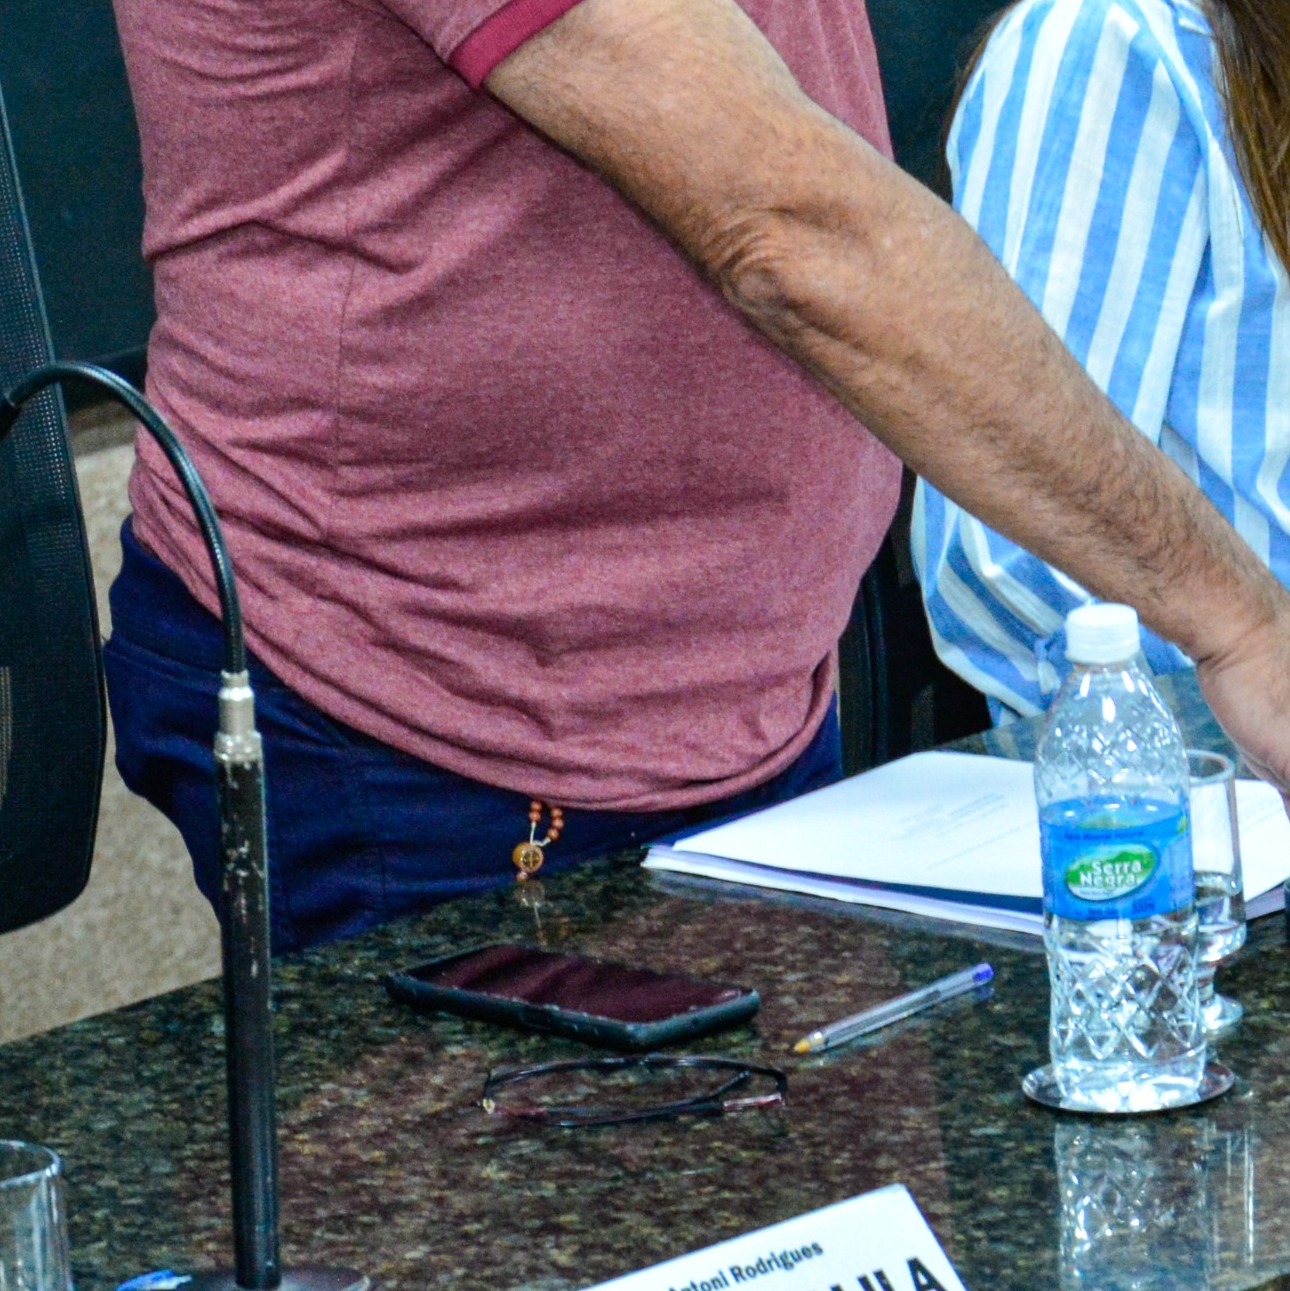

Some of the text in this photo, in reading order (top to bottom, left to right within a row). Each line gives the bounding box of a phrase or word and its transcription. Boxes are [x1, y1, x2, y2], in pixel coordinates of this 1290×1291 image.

[1091, 859, 1143, 875] Serra
[1079, 871, 1136, 891] Negra
[668, 1241, 824, 1291] toni Rodrigues
